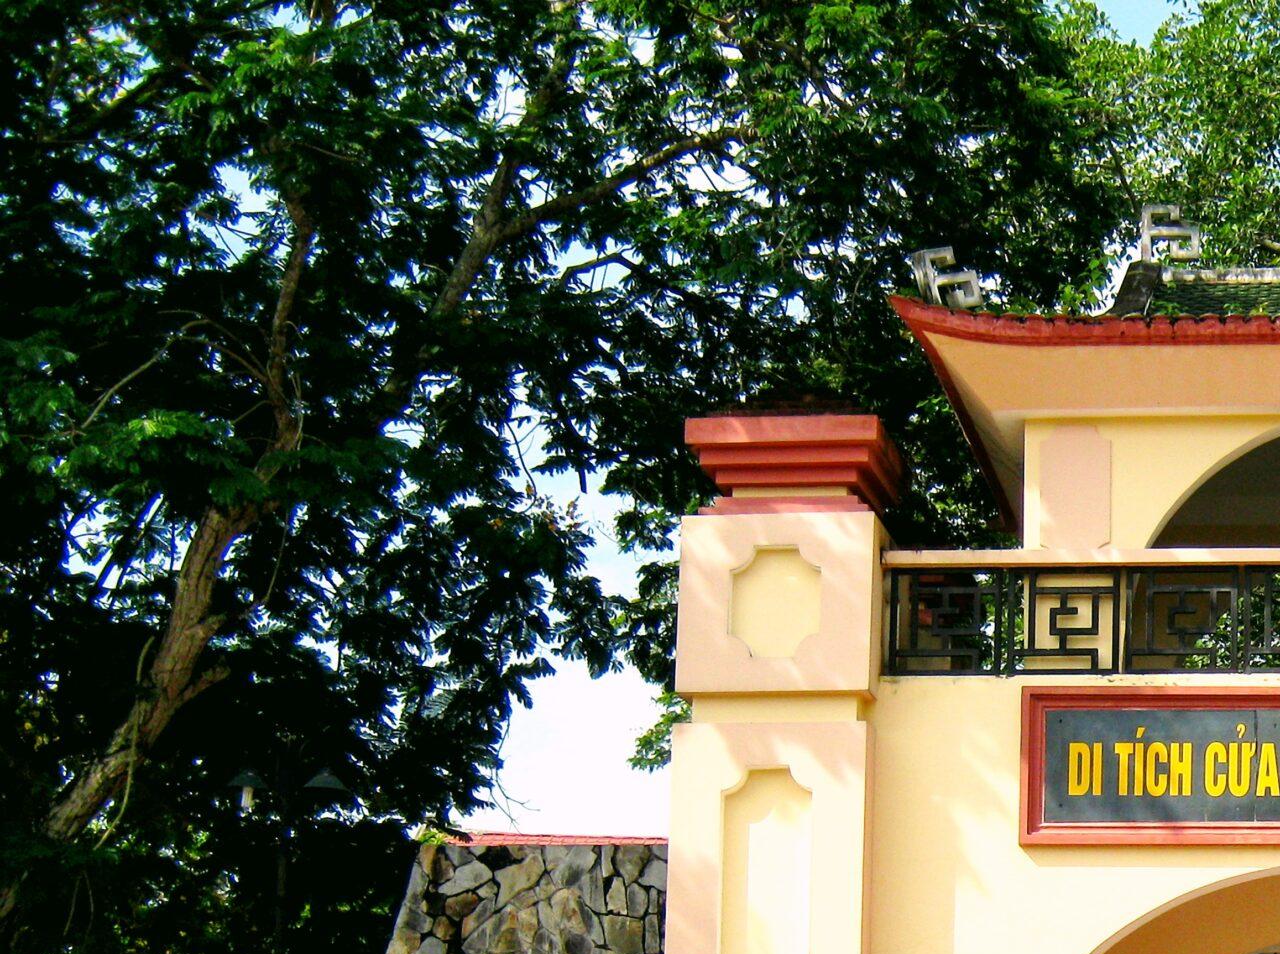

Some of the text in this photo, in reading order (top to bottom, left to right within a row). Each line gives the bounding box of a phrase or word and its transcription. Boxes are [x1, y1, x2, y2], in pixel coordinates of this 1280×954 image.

[1067, 741, 1104, 797] DI
[1113, 726, 1194, 798] TÍCH
[1204, 723, 1280, 799] CỬA
